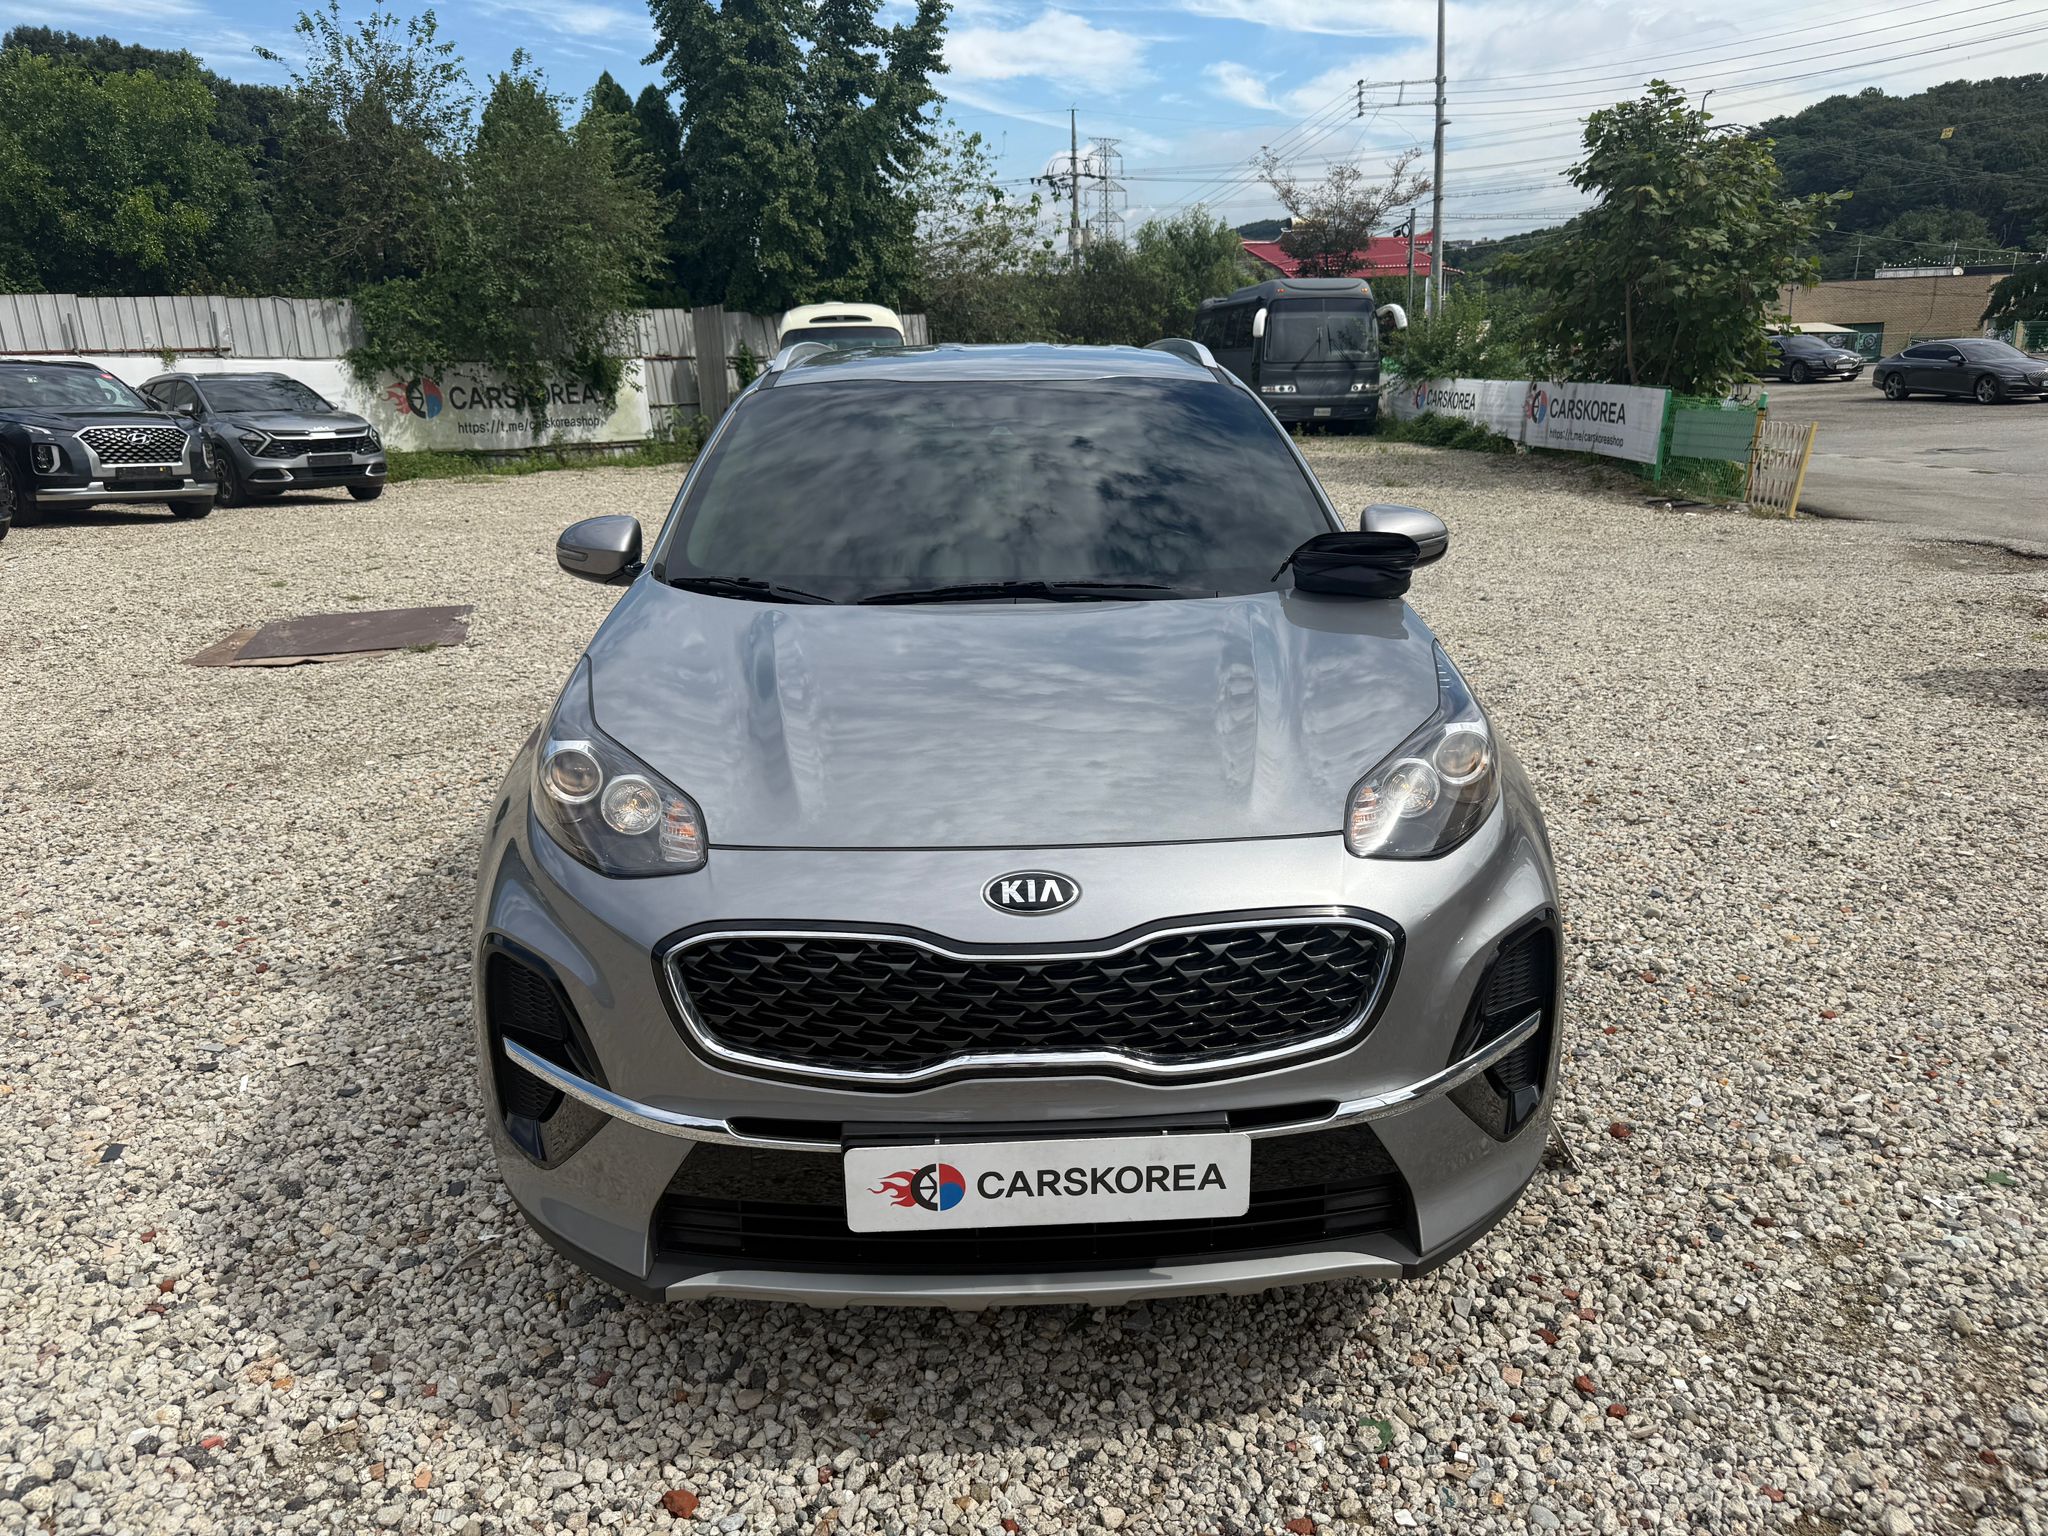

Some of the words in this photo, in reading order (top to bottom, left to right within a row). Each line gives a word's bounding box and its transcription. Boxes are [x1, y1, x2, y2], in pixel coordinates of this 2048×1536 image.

[1427, 389, 1476, 410] CARSKOREA
[1550, 399, 1626, 424] CARSKOREA
[458, 416, 600, 434] https://t.me/crskoreashop
[1549, 428, 1624, 447] https://t.me/carskoreashop
[1001, 879, 1064, 904] KIA
[977, 1163, 1226, 1200] CARSKOREA
